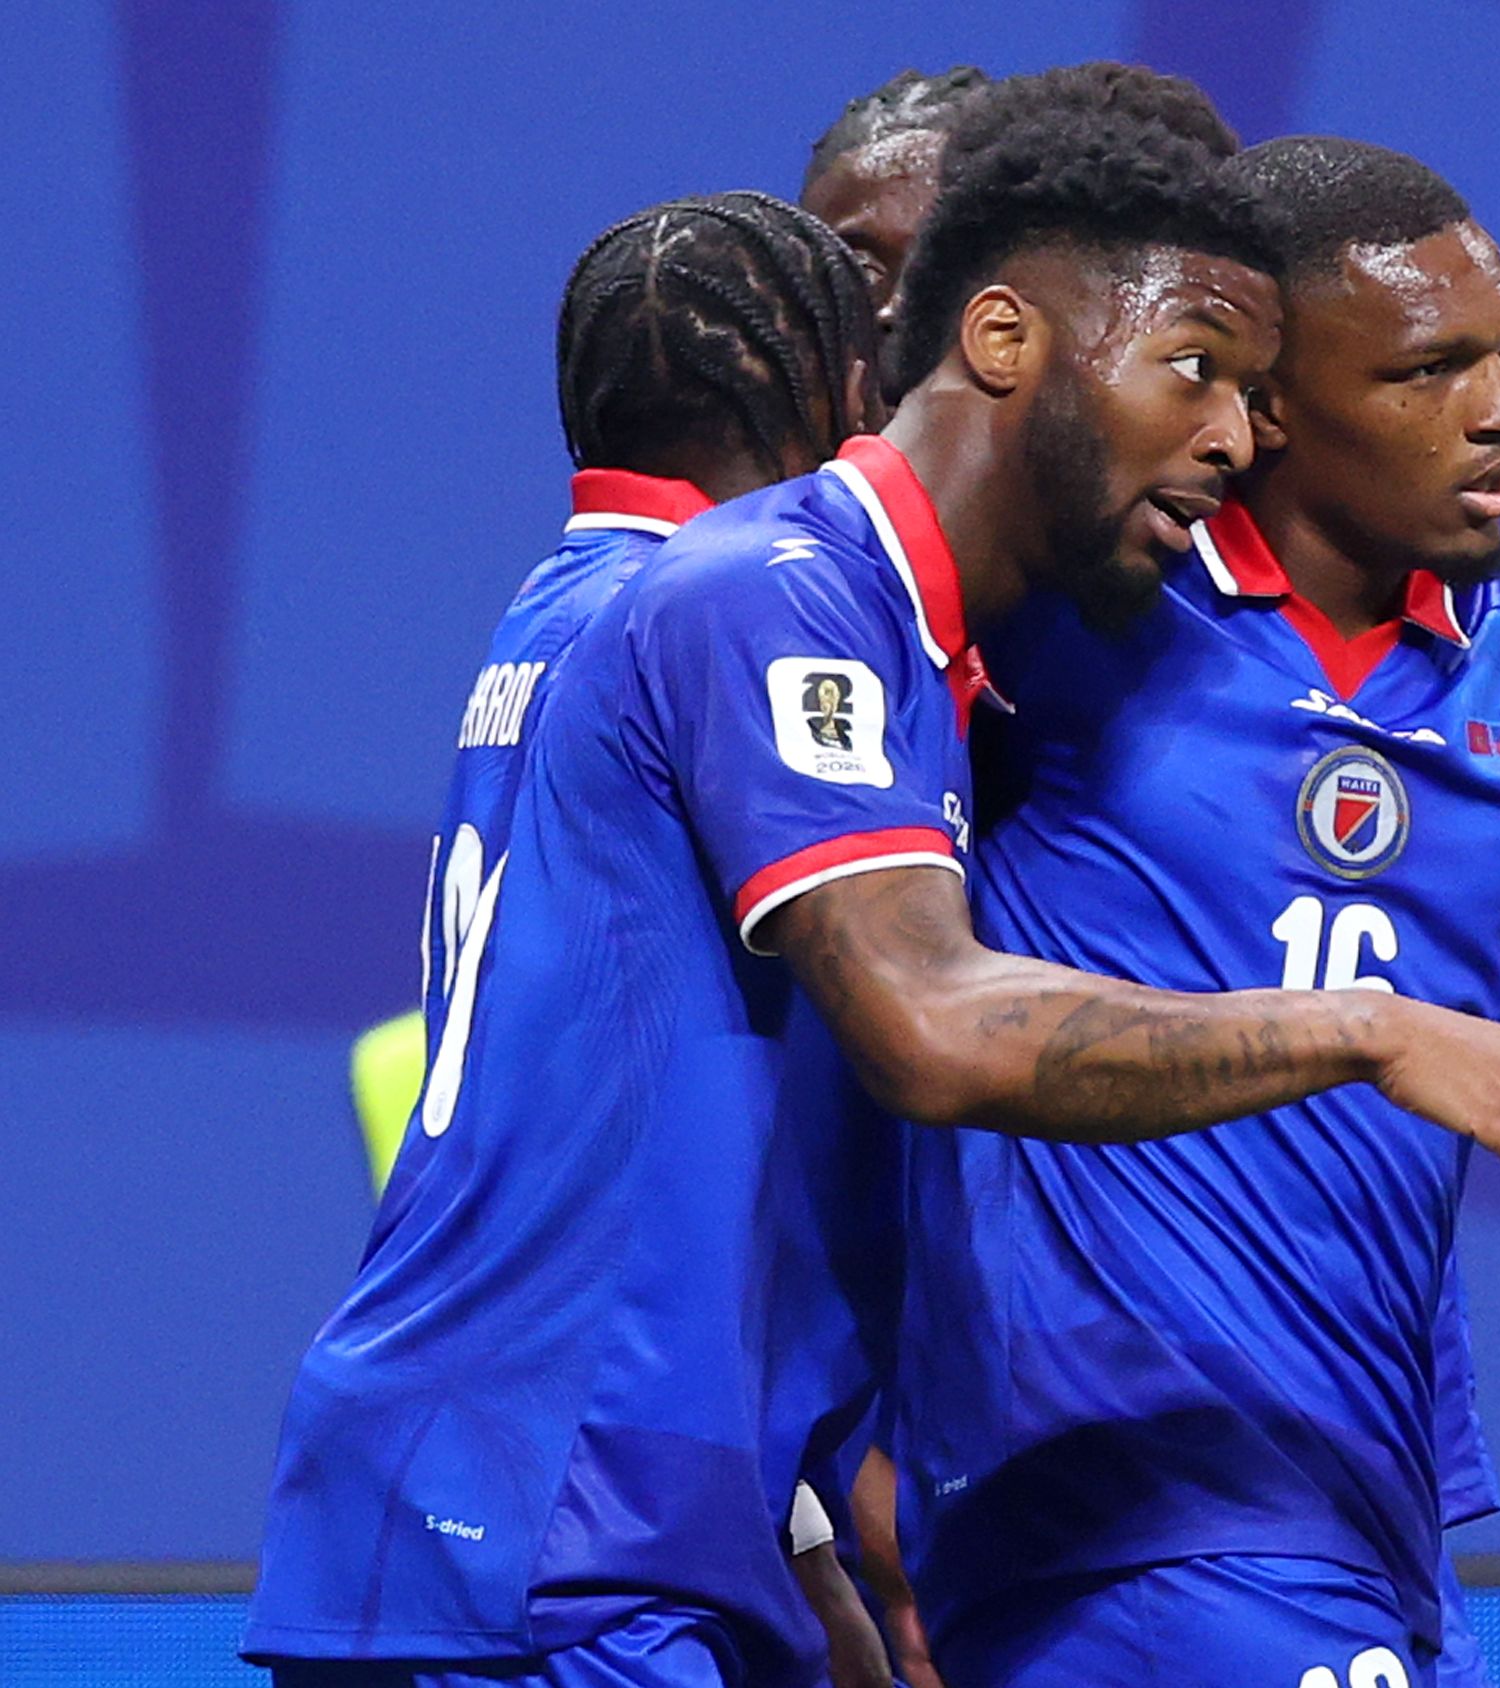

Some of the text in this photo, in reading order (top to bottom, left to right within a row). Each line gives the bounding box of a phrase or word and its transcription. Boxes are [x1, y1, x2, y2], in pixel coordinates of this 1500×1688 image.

[1341, 779, 1379, 793] HAITI
[1272, 896, 1398, 992] 16
[425, 1514, 485, 1541] S-dried
